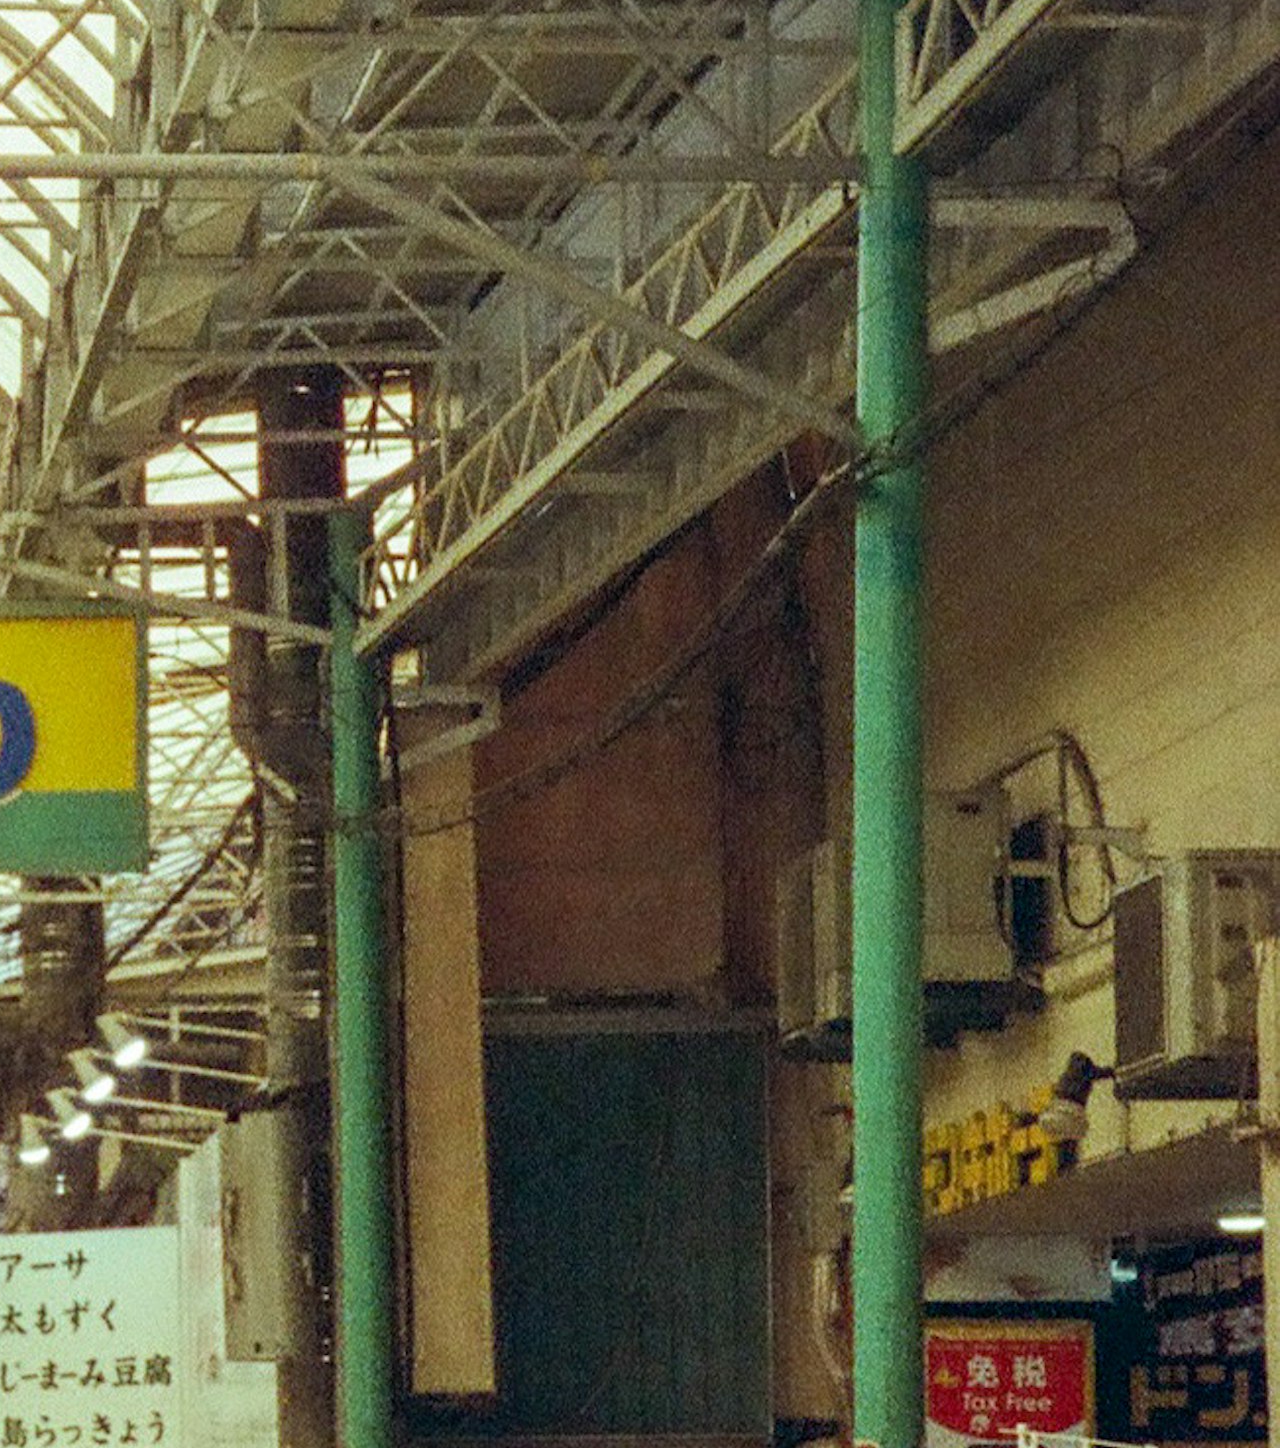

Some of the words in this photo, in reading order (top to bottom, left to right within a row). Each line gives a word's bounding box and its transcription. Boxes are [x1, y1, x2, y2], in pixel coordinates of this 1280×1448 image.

[0, 1298, 117, 1335] 太もずく
[0, 1353, 173, 1393] じーまーみ豆腐
[963, 1393, 997, 1412] Tax
[1006, 1393, 1053, 1413] Free
[1, 1410, 166, 1448] 島らっきょう
